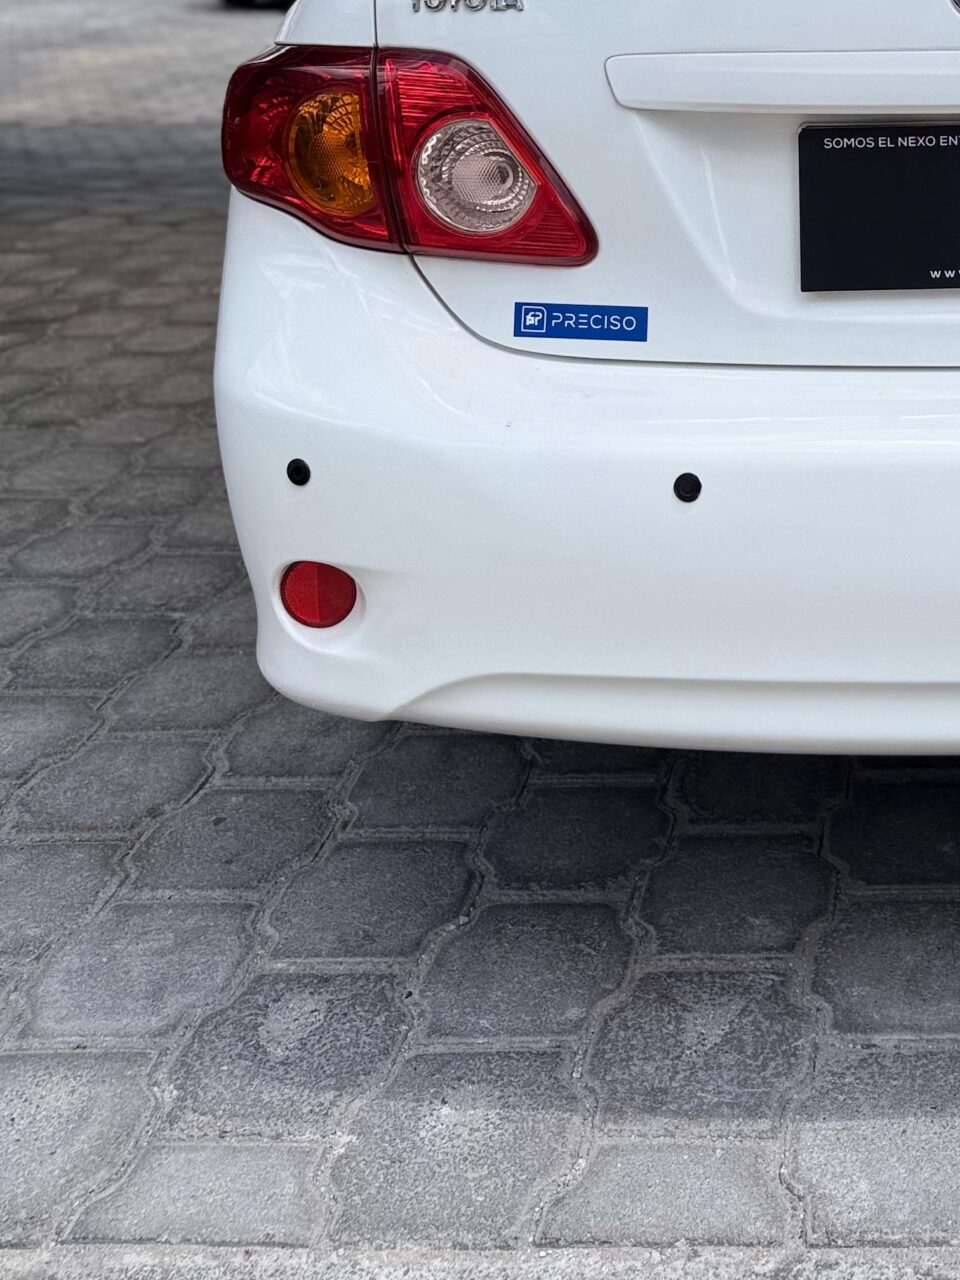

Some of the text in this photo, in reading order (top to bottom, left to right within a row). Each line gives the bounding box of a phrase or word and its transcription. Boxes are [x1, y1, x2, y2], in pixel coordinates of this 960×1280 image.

[824, 137, 875, 149] SOMOS
[878, 137, 895, 148] EL
[898, 136, 936, 147] NEXO
[551, 312, 637, 331] PRECISO
